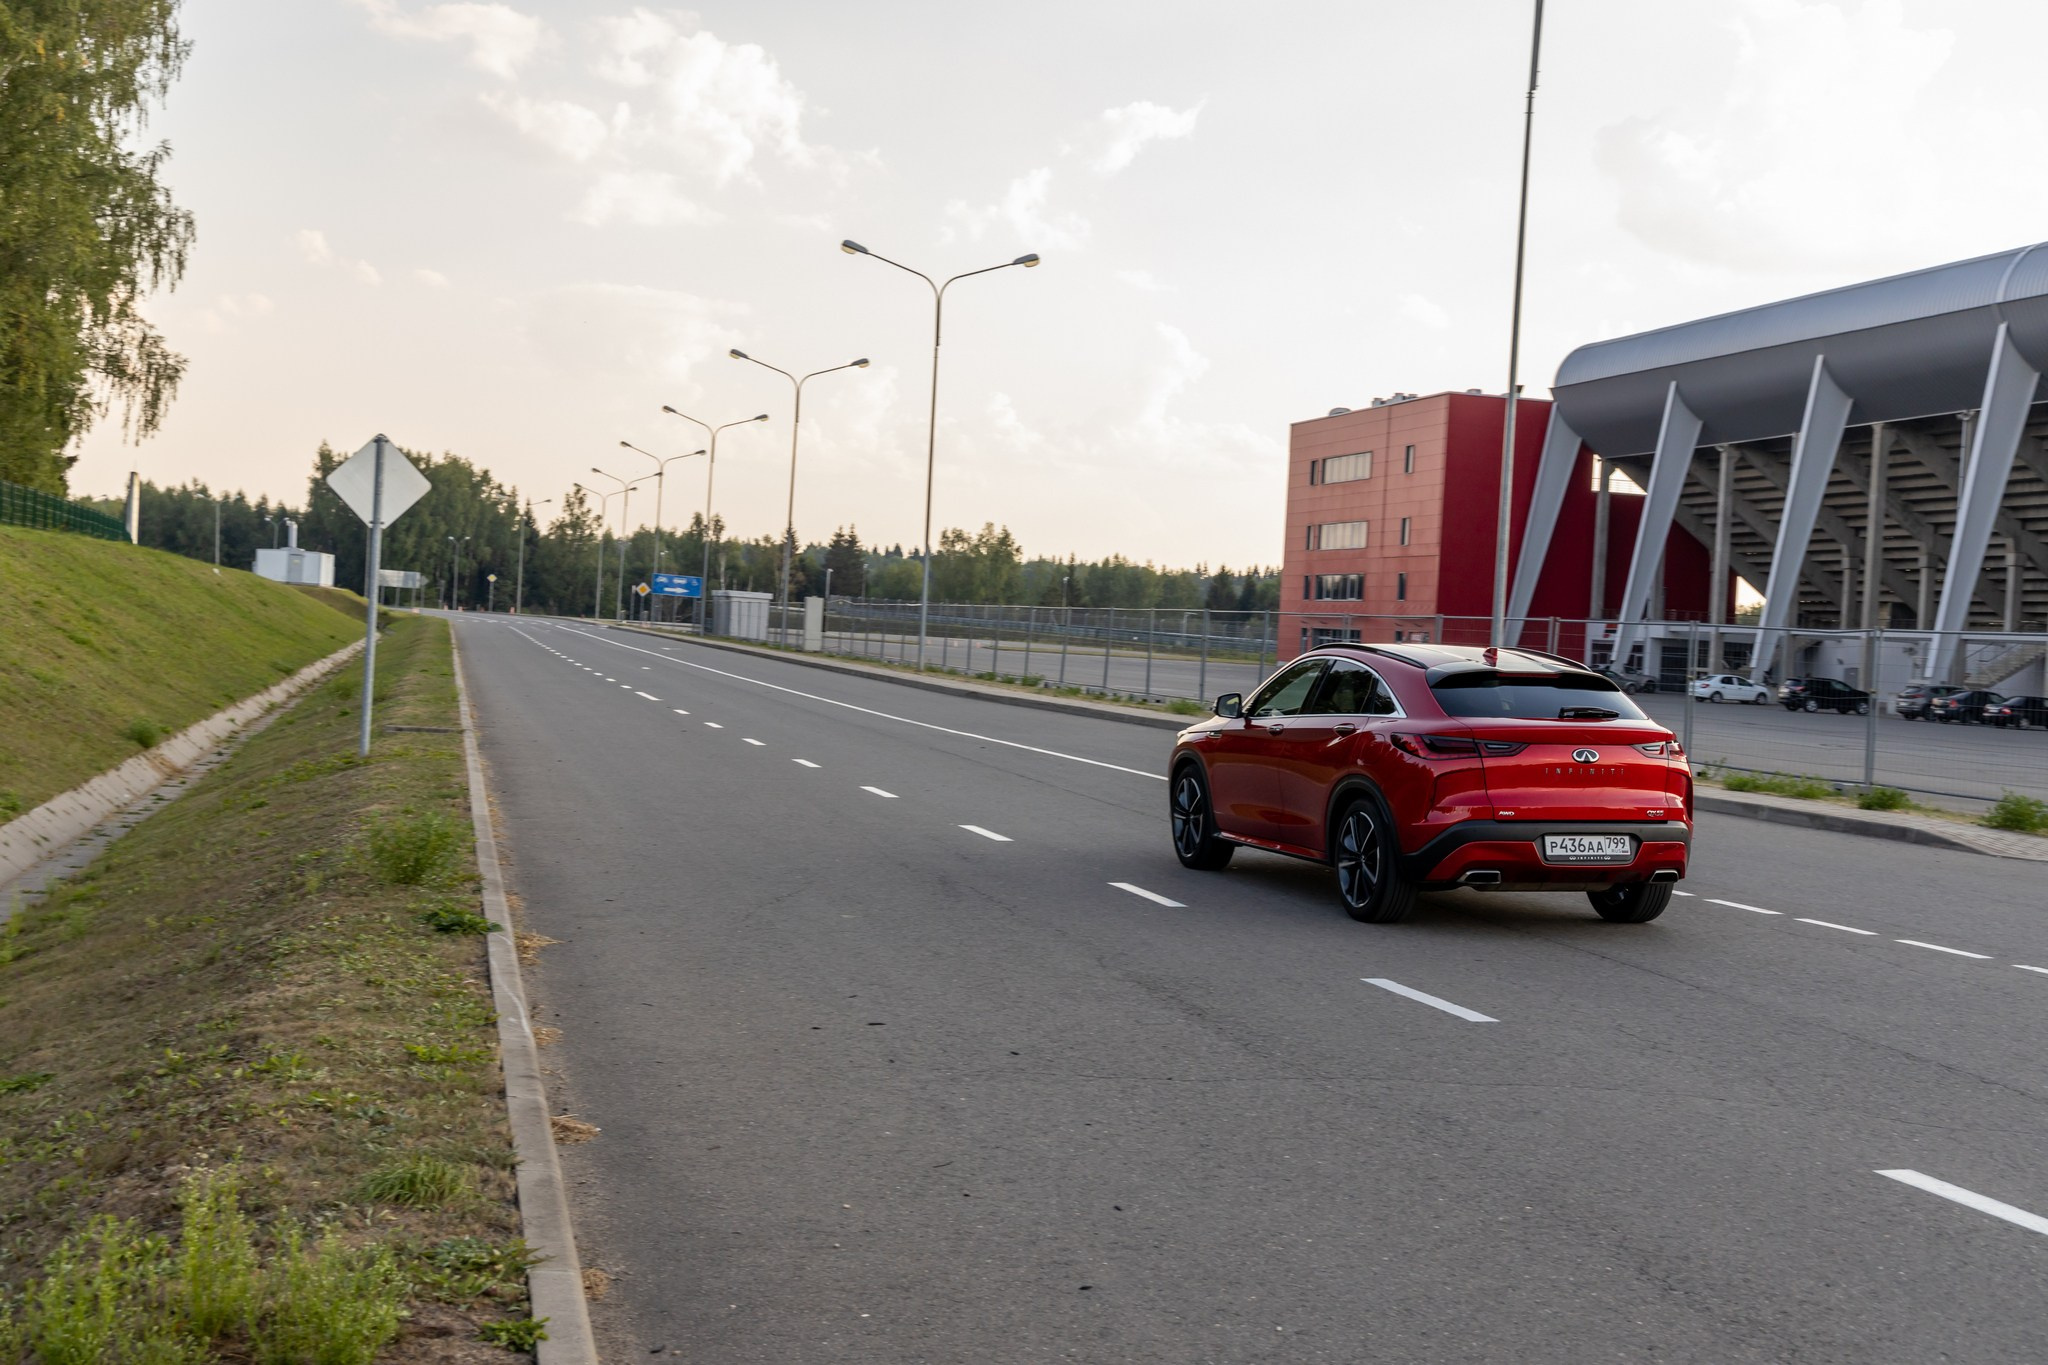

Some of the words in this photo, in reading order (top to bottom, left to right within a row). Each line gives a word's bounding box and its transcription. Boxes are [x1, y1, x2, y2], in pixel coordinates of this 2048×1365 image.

[1545, 767, 1624, 775] INFINITI
[1550, 838, 1605, 854] P436AA
[1605, 837, 1626, 849] 799
